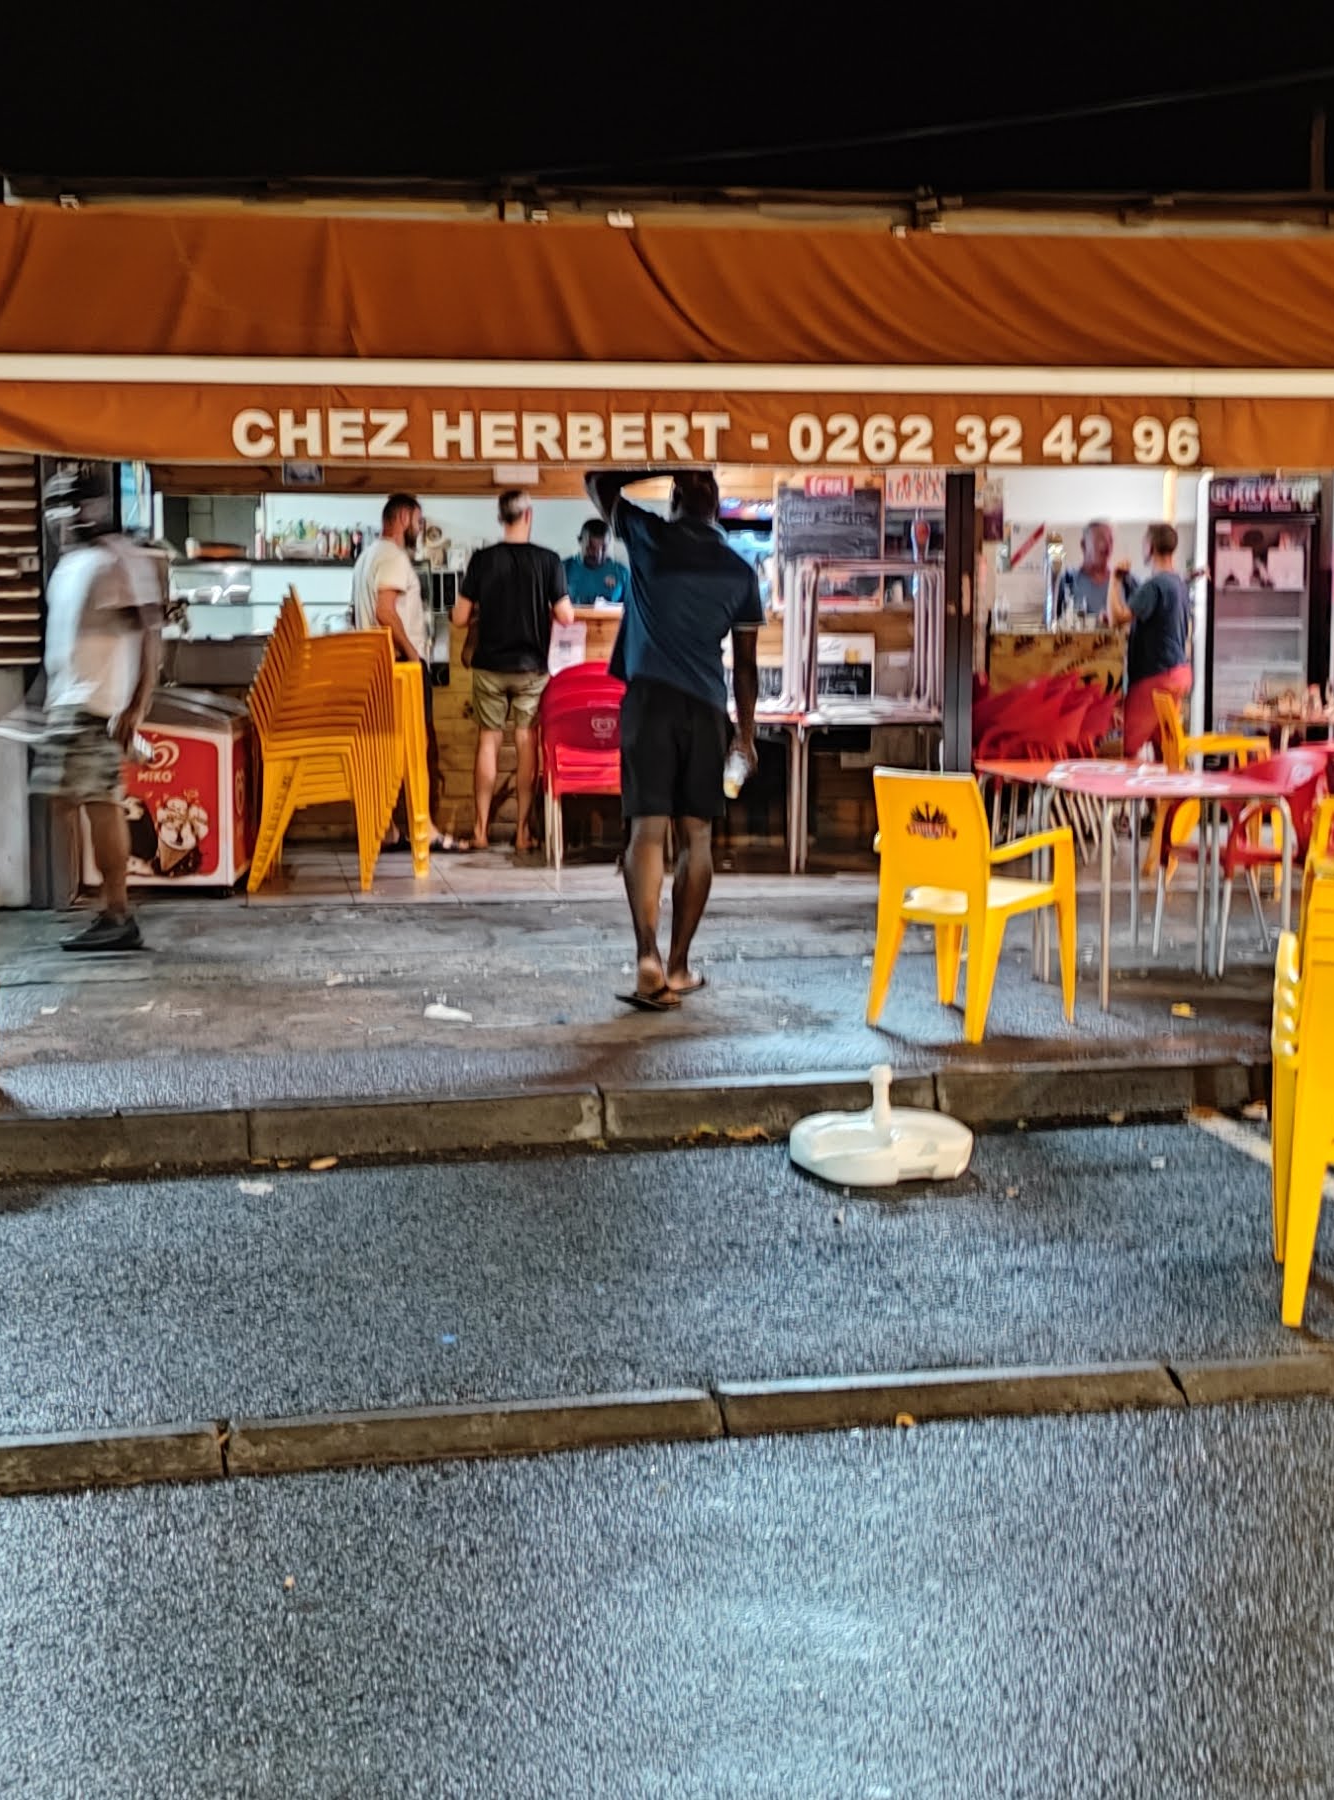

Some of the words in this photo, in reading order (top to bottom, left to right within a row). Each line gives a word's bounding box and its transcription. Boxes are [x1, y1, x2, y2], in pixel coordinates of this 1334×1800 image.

[231, 407, 411, 459] CHEZ
[432, 410, 731, 462] HERBERT
[750, 432, 769, 451] -
[788, 412, 934, 464] 0262
[954, 414, 1023, 464] 32
[1042, 414, 1113, 464] 42
[1131, 416, 1201, 467] 96
[137, 769, 173, 783] MIKO
